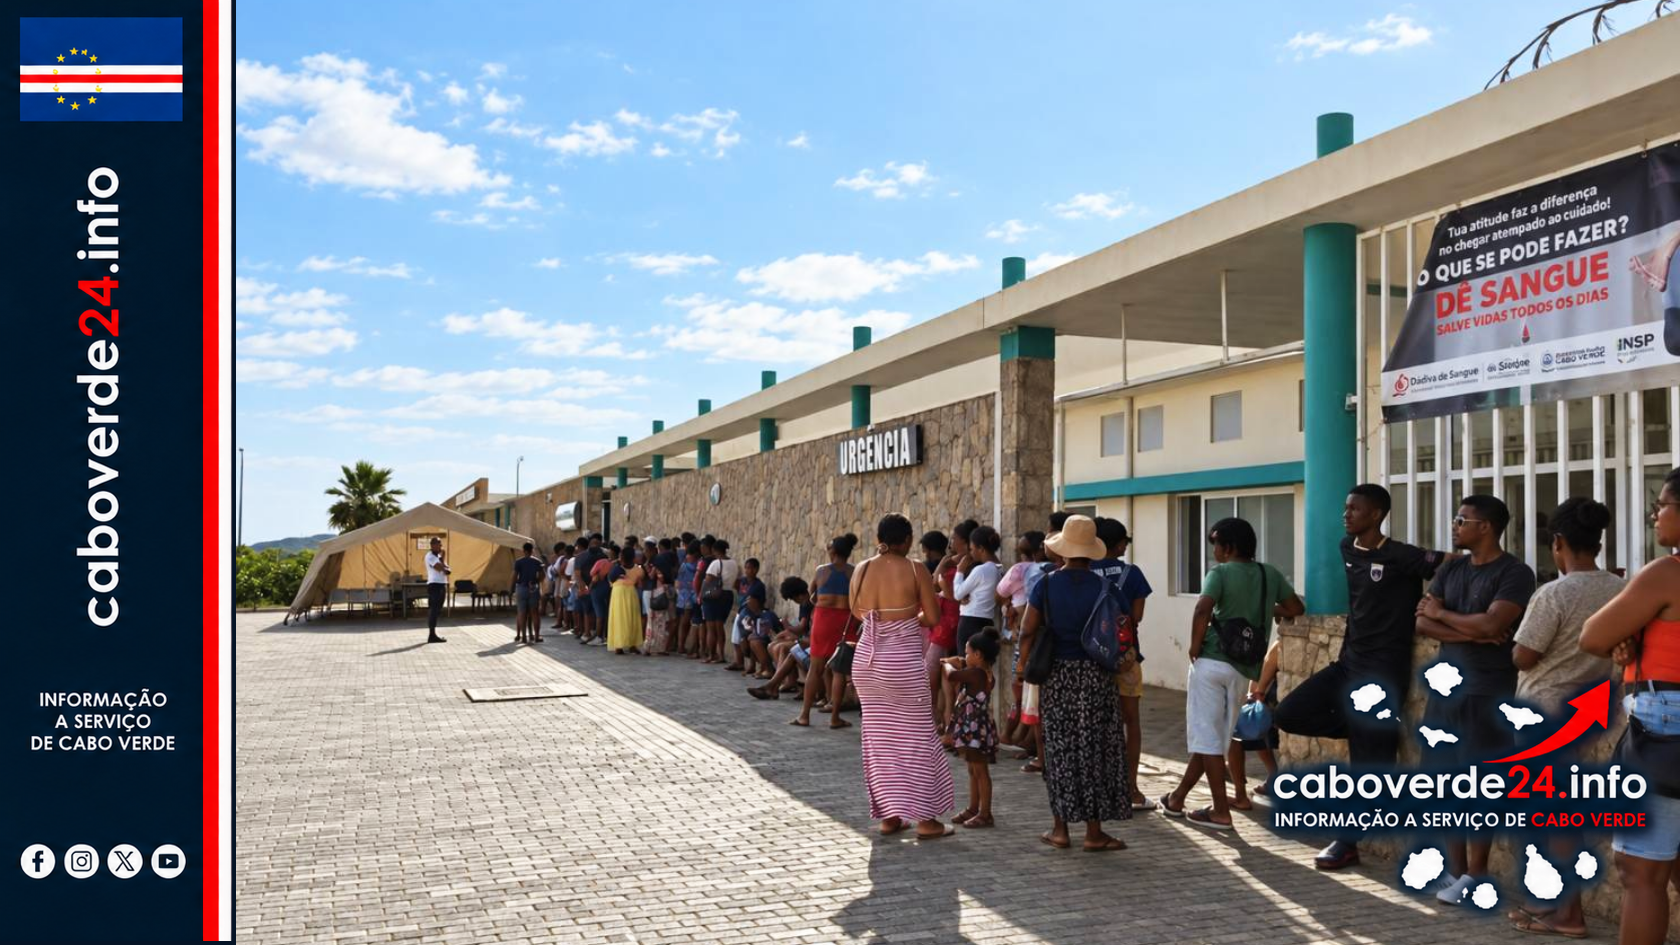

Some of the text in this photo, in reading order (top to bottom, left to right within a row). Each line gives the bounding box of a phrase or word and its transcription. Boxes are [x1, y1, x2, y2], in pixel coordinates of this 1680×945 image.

[1439, 197, 1611, 256] no chegar atempado ao cuidado!
[1448, 185, 1598, 239] Tua atitude faz a diferença
[1417, 215, 1630, 286] O QUE SE PODE FAZER?
[1436, 251, 1609, 319] DÊ SANGUE
[1436, 287, 1609, 336] SALVE VIDAS TODOS OS DIAS
[1438, 371, 1448, 381] de
[1449, 367, 1479, 380] Sangue
